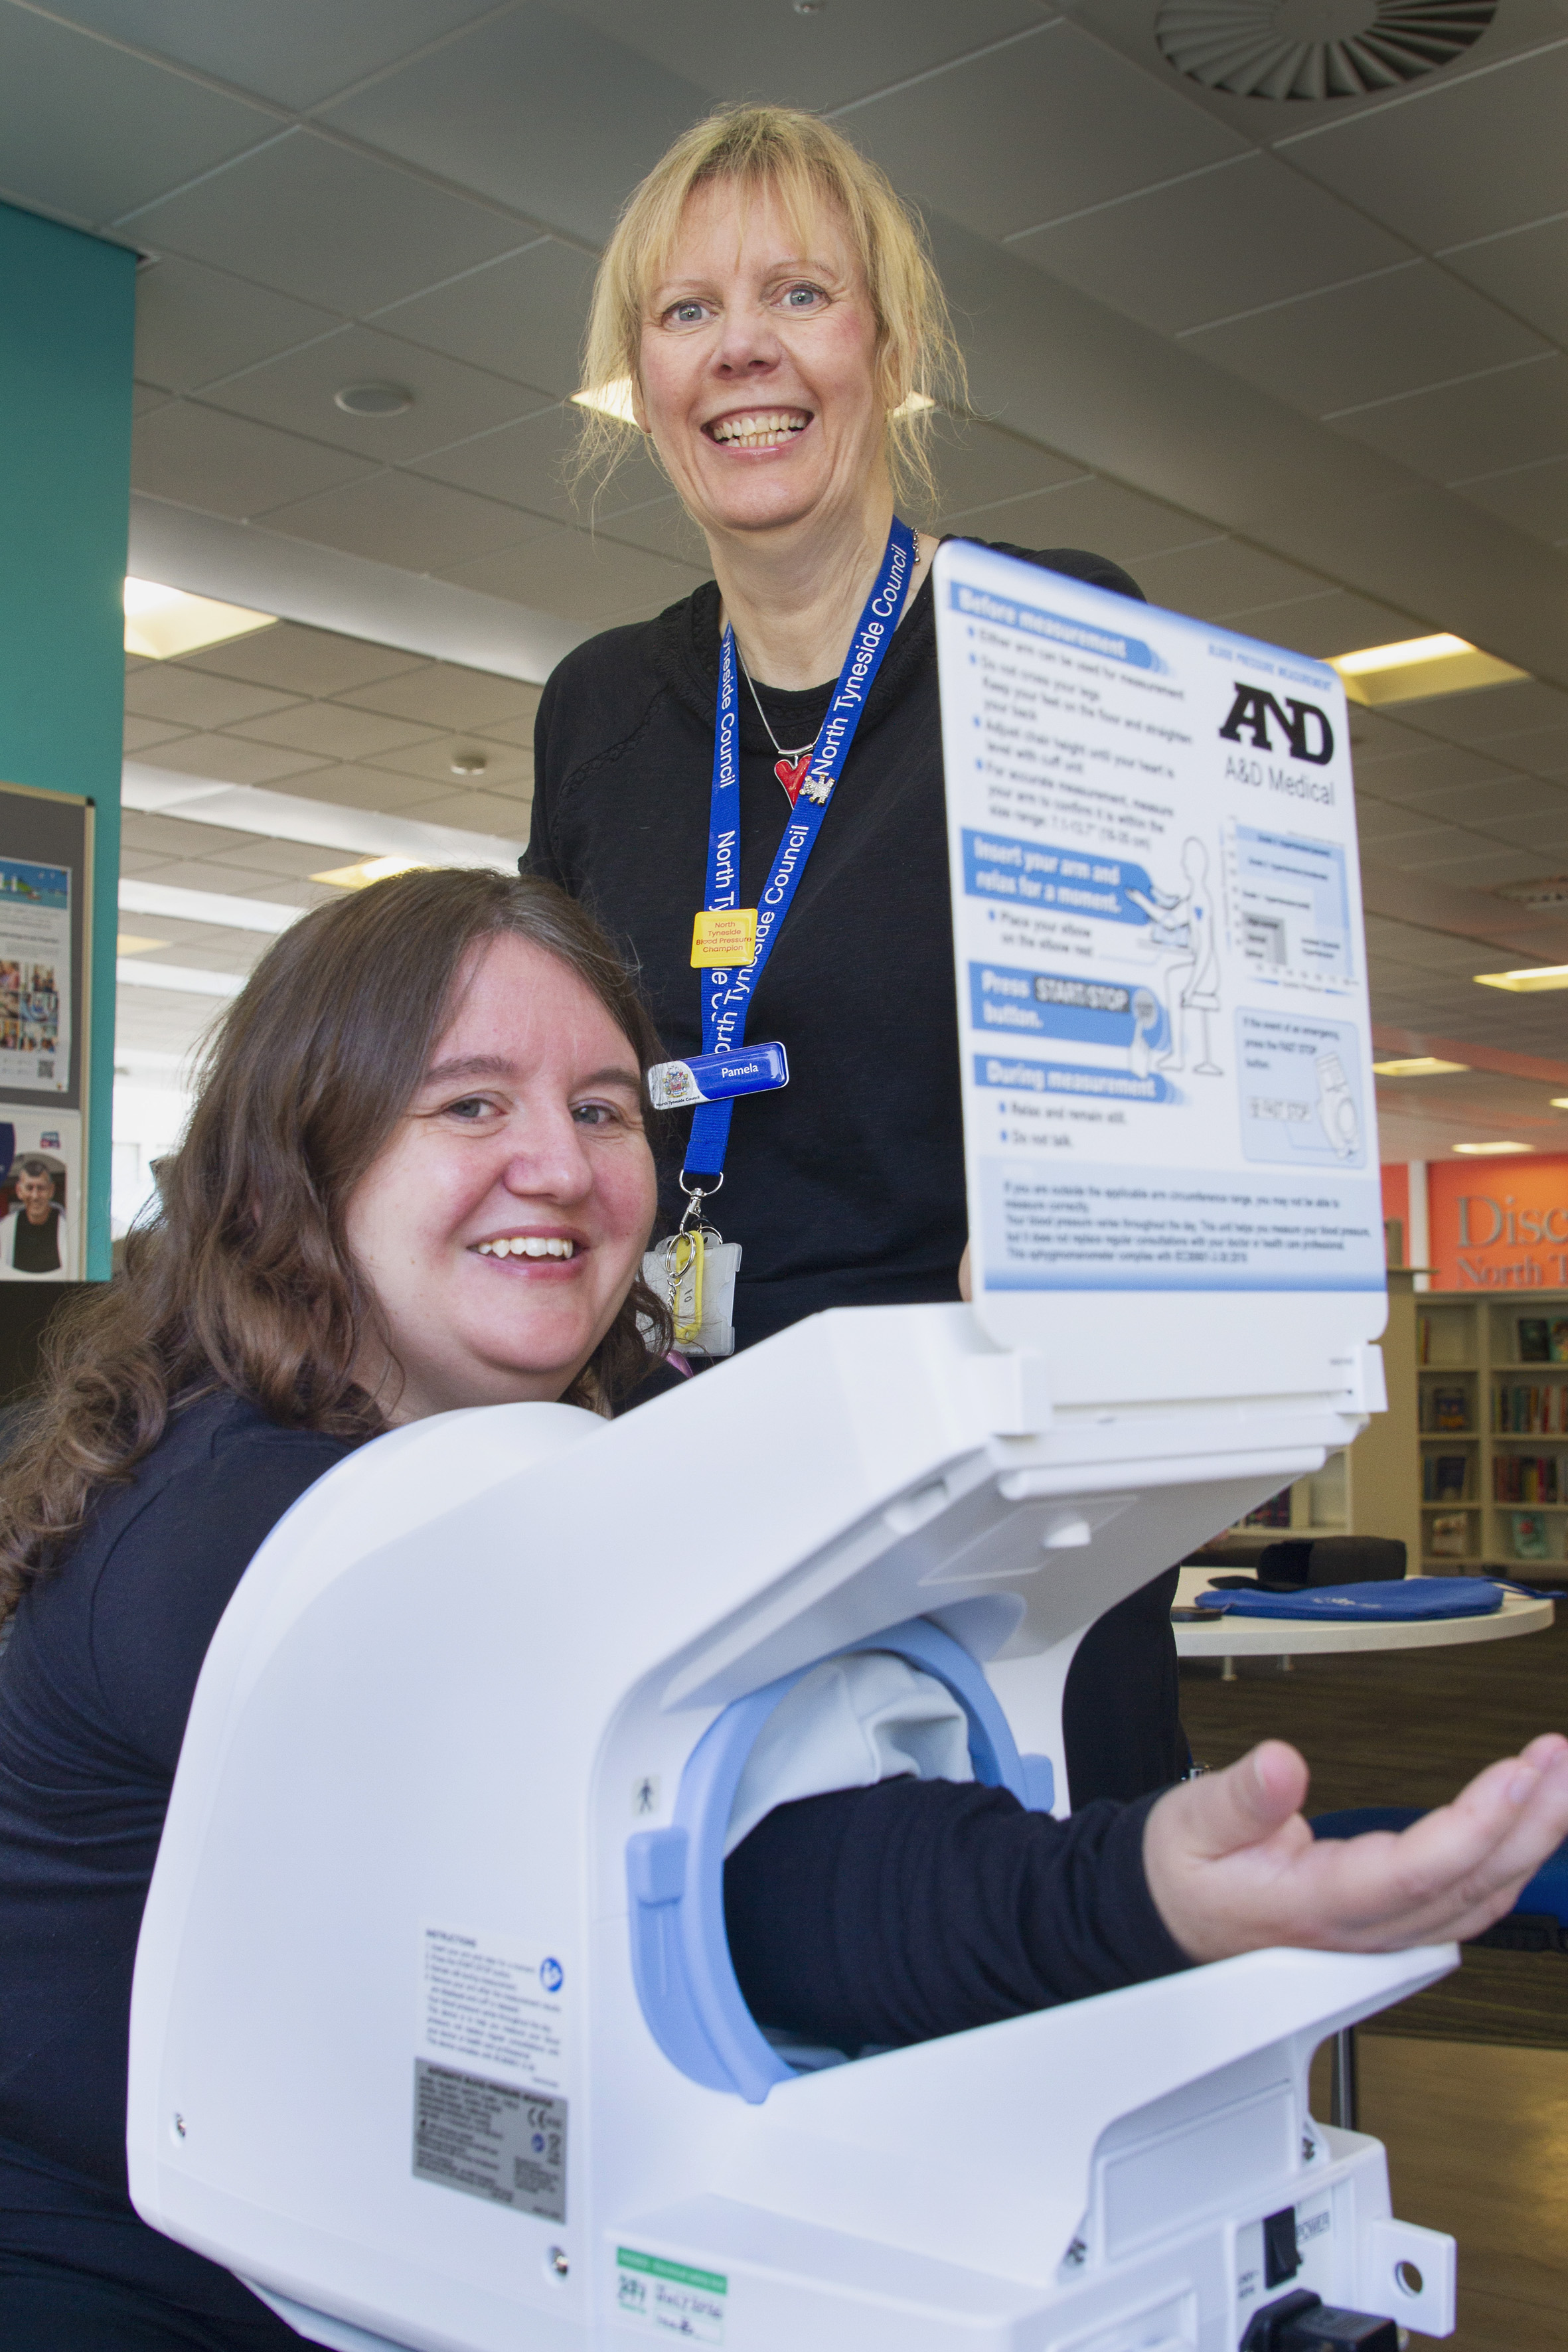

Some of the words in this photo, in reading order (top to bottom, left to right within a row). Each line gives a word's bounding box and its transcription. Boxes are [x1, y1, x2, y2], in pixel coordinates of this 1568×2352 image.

[959, 588, 1016, 624] Before
[1019, 612, 1127, 657] measurement
[722, 623, 734, 710] yneside
[811, 716, 848, 776] North
[834, 622, 884, 710] Tyneside
[872, 544, 907, 617] Council
[720, 713, 735, 788] Council
[1219, 682, 1336, 765] AND
[1225, 755, 1262, 787] A&D
[1268, 768, 1335, 805] Medical
[716, 830, 735, 888] North
[974, 836, 1022, 867] Insert
[1023, 851, 1059, 878] your
[1059, 858, 1091, 882] arm
[1092, 860, 1121, 888] and
[975, 867, 1016, 895] relax
[1018, 874, 1042, 900] for
[1044, 883, 1056, 903] a
[714, 1012, 738, 1054] orth
[765, 824, 809, 904] Council
[981, 969, 1030, 998] Press
[722, 1063, 758, 1078] Pamela
[985, 1059, 1045, 1091] During
[1047, 1071, 1156, 1098] measurement
